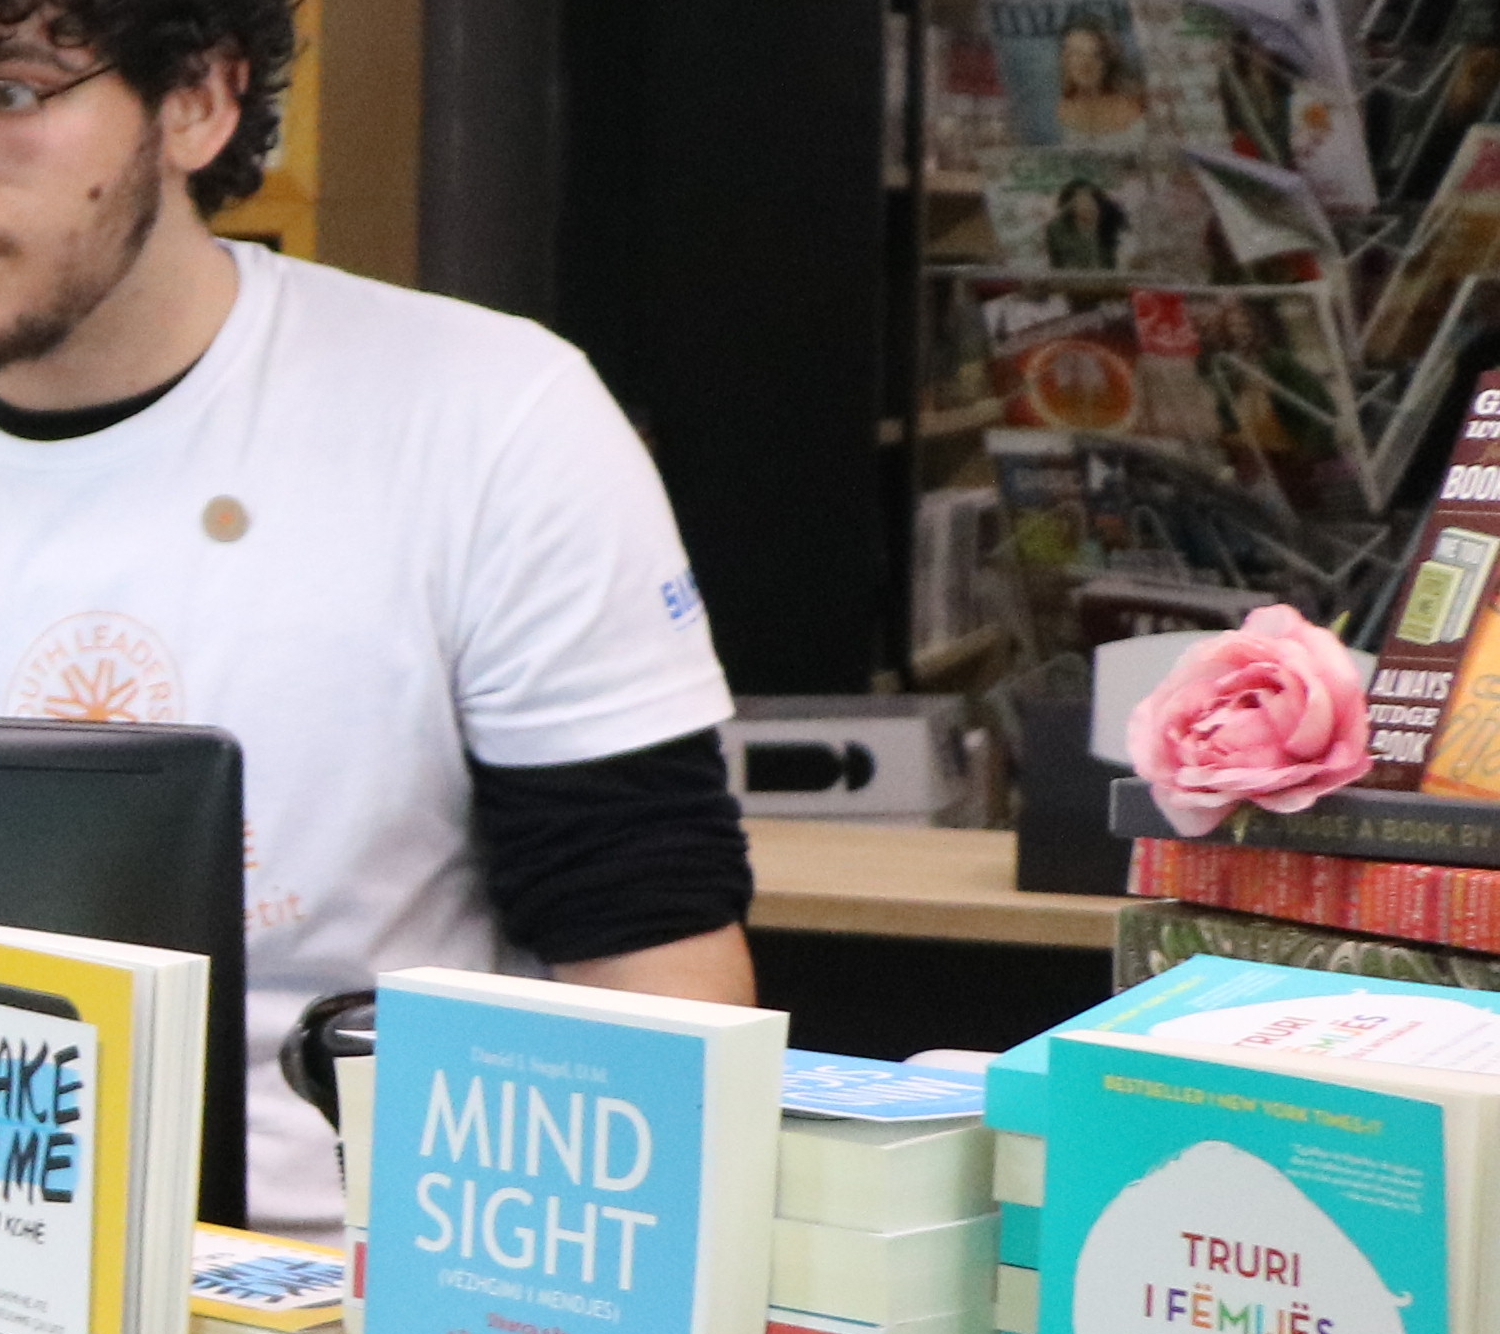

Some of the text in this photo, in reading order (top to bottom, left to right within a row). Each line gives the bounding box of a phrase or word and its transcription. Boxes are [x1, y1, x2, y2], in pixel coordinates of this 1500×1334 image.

[74, 624, 174, 721] LEADERS
[418, 1067, 654, 1193] MIND
[414, 1170, 660, 1292] SIGHT
[1181, 1230, 1302, 1288] TRURI
[1144, 1282, 1155, 1318] I
